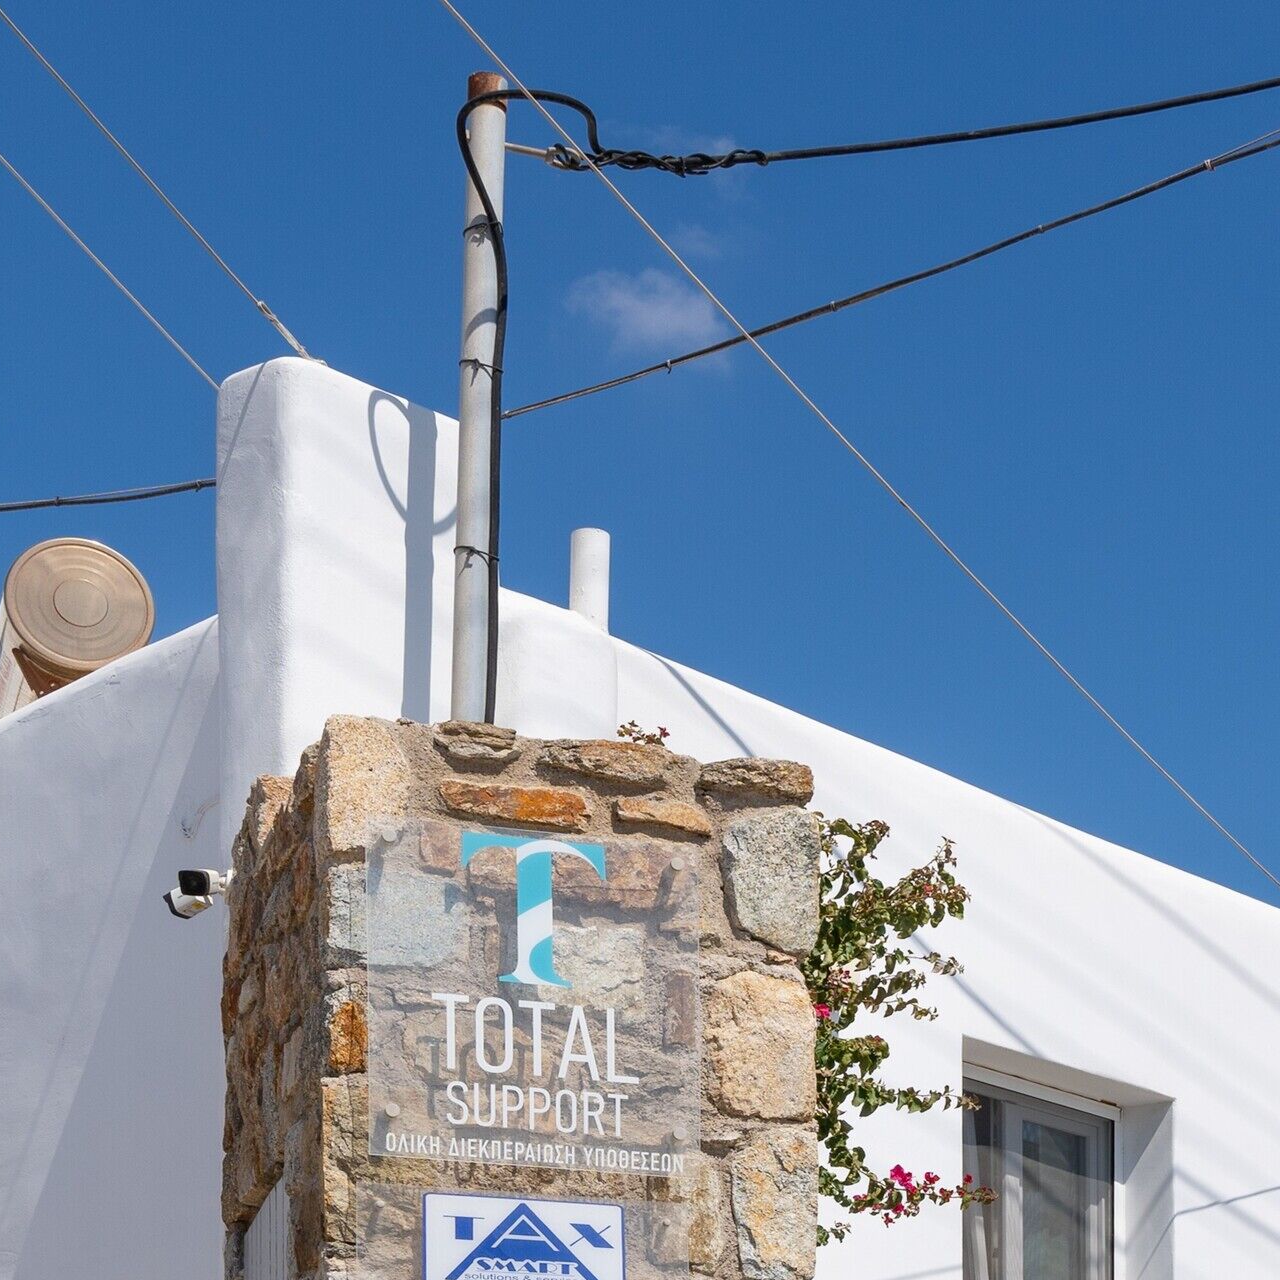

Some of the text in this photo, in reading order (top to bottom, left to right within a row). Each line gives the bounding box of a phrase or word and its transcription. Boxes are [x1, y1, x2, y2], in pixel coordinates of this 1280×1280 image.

[432, 993, 639, 1085] TOTAL
[446, 1081, 629, 1137] SUPPORT
[385, 1132, 685, 1174] ΟΛΙΚΗ ΔΙΕΚΠΕΡΑΙΩΣΗ ΥΠΟΘΕΣΕΩΝ
[475, 1258, 576, 1275] SMART
